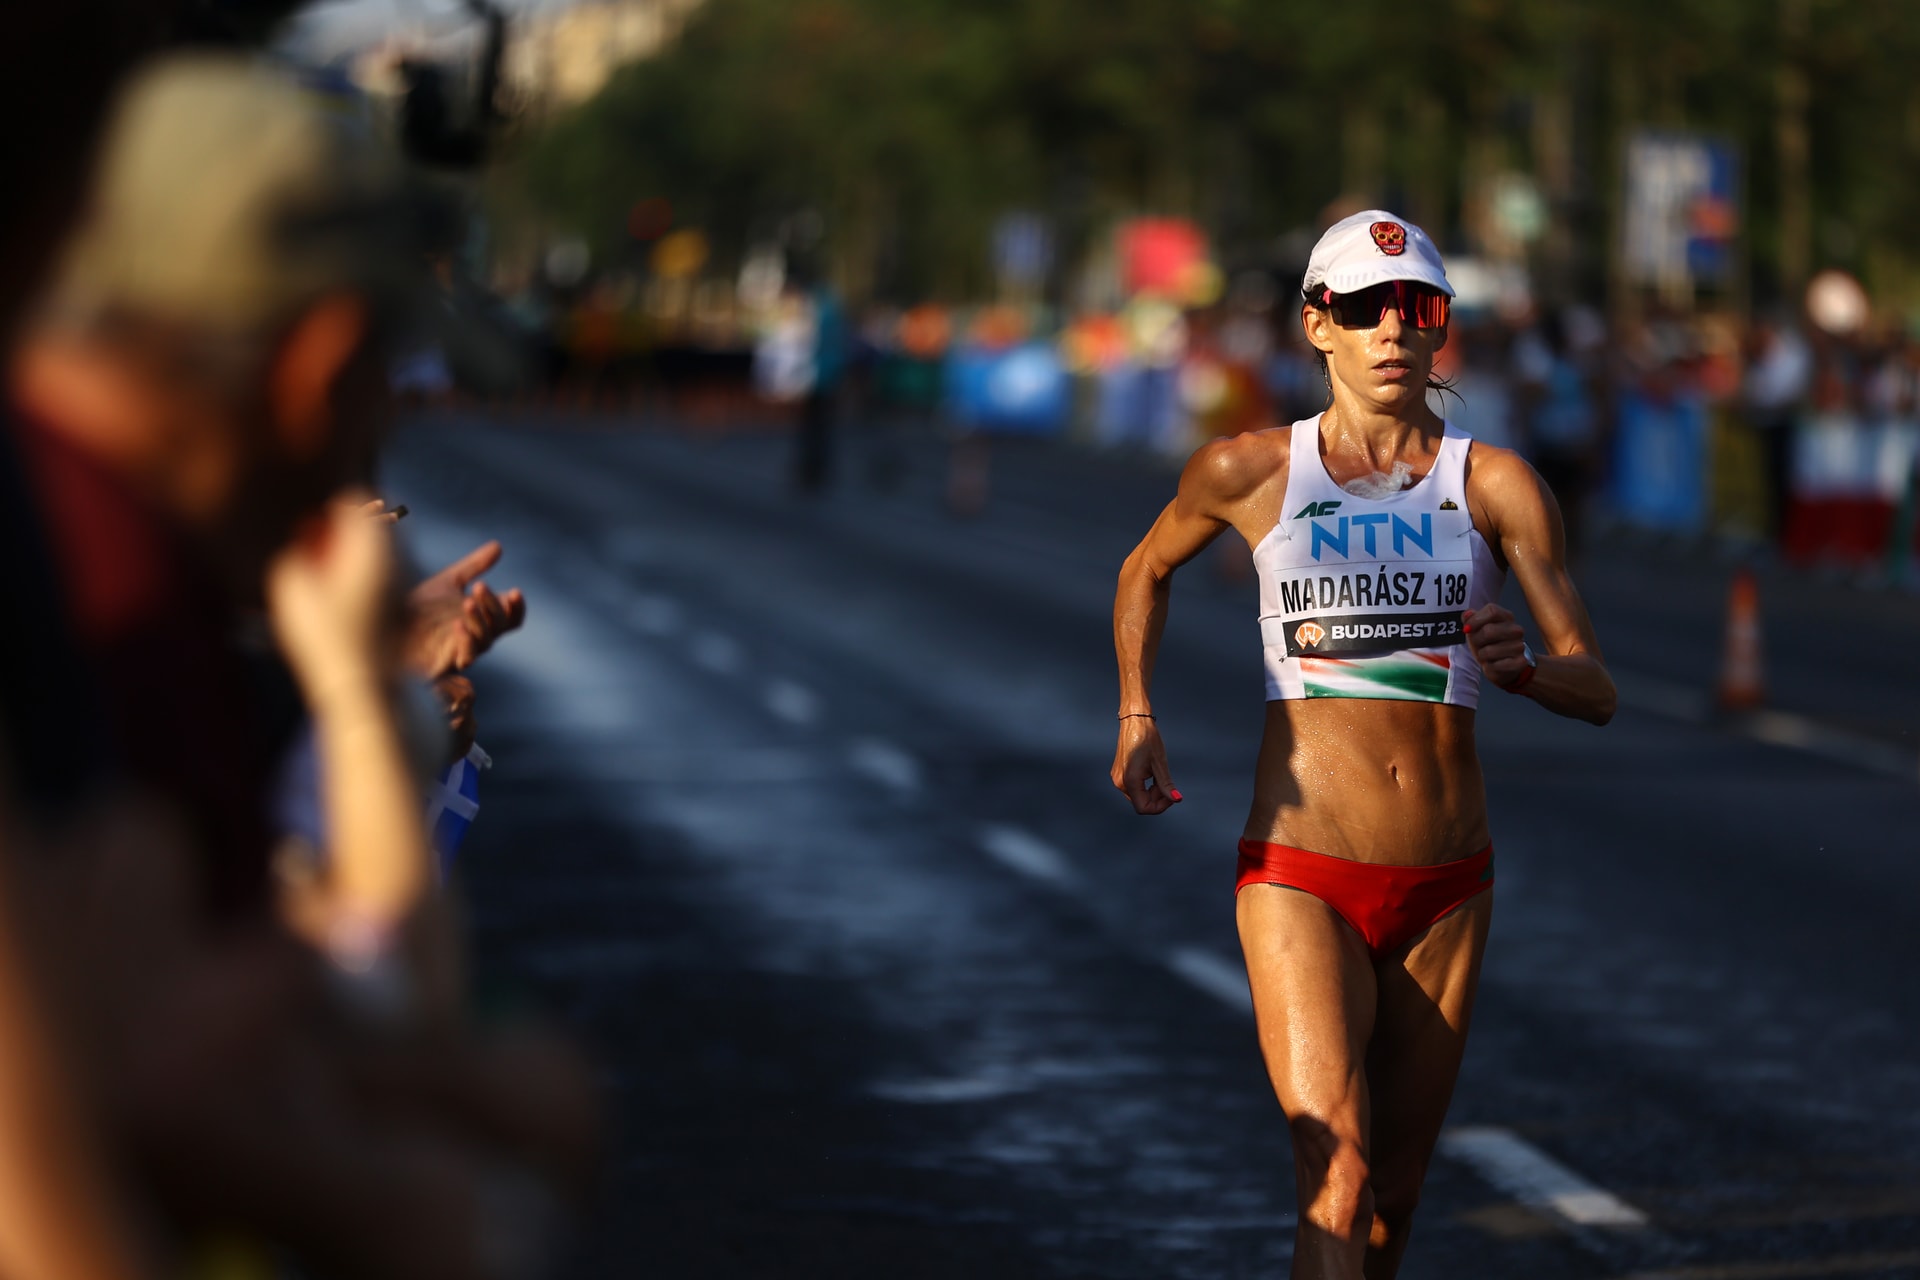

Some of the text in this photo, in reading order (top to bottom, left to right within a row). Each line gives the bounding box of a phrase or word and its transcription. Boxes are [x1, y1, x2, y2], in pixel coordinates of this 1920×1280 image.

[1311, 513, 1433, 562] NTN
[1281, 565, 1467, 614] MADARÁSZ 138
[1331, 623, 1435, 640] BUDAPEST
